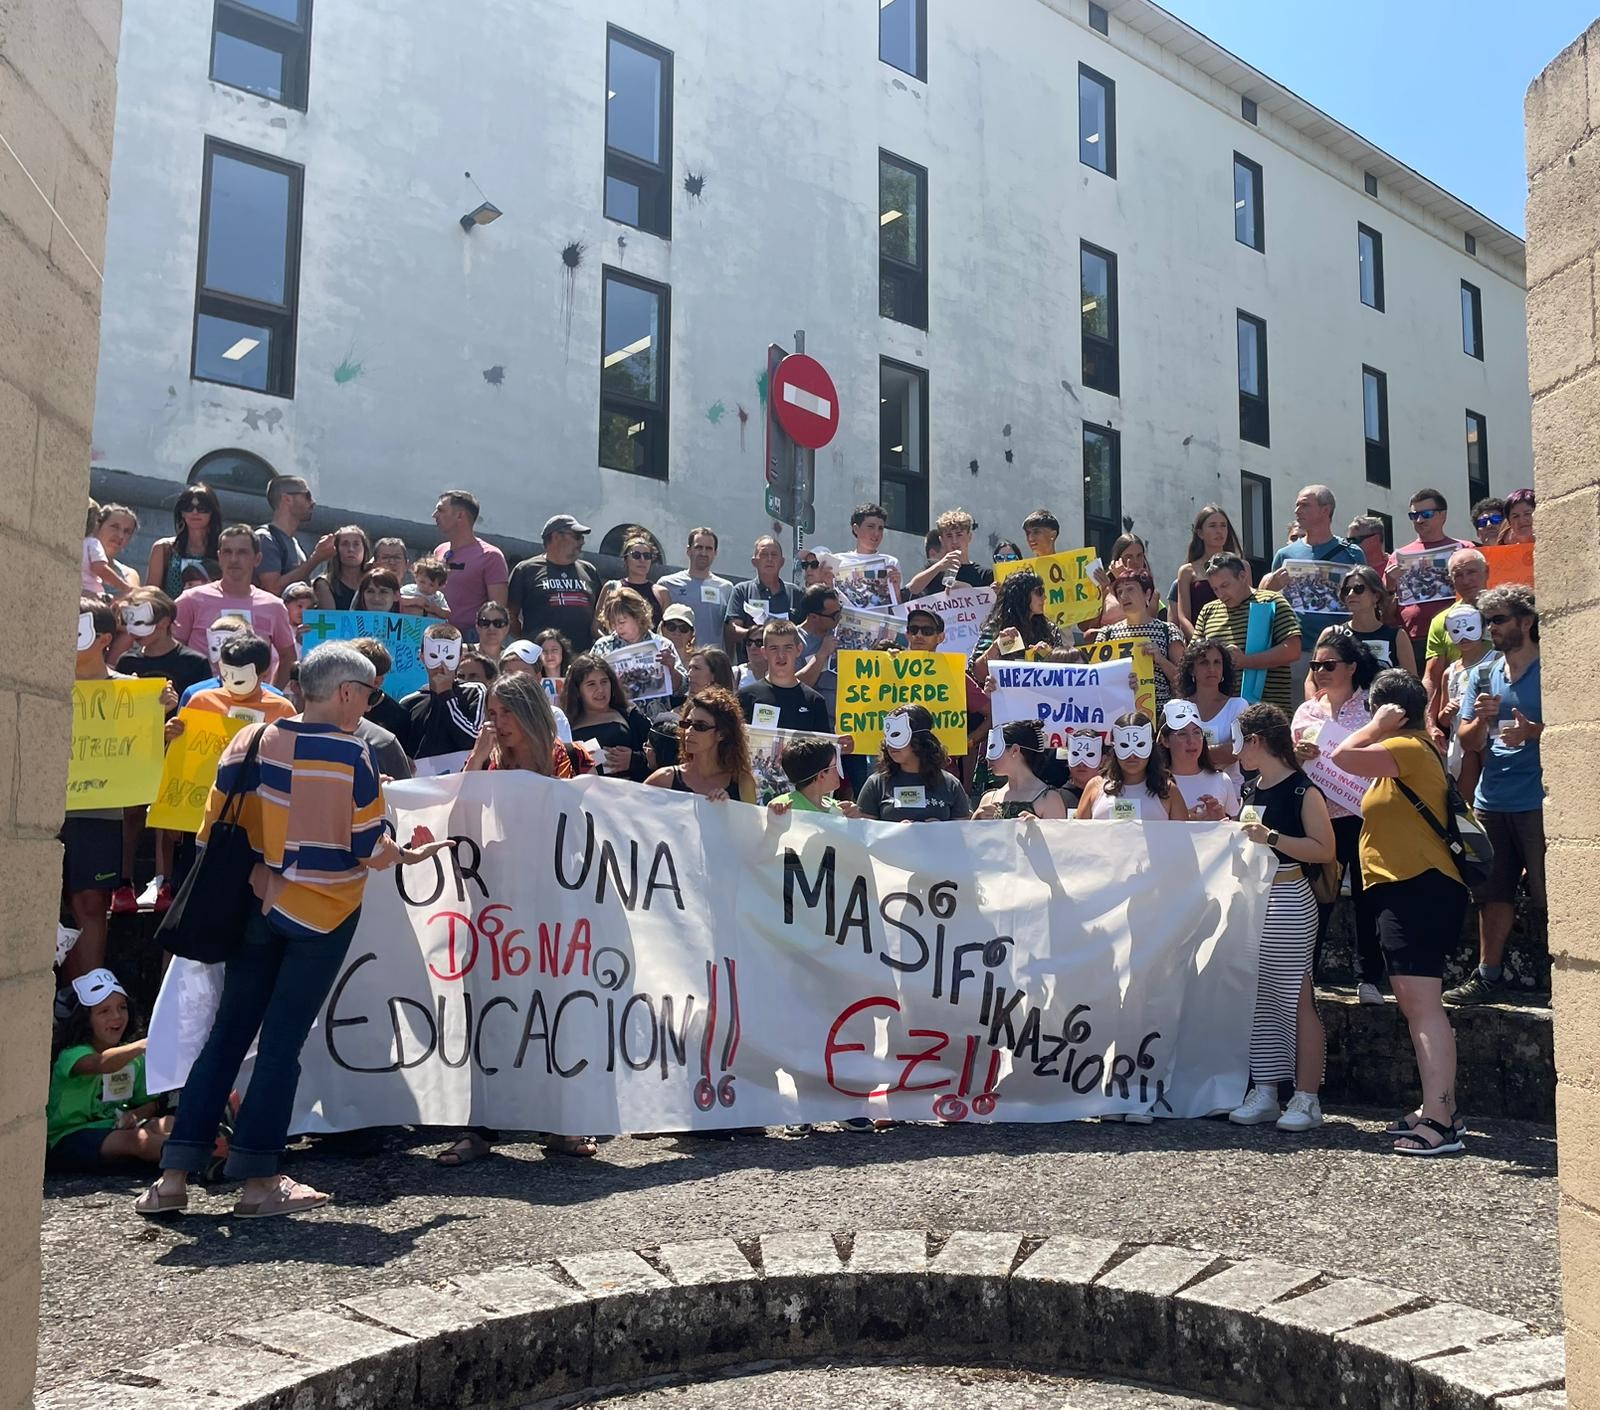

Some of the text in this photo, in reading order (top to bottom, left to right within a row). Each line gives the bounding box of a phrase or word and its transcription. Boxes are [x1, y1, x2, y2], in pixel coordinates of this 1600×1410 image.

[542, 579, 587, 590] NORWAY
[976, 593, 991, 605] EZ
[1456, 619, 1467, 628] 23
[436, 644, 449, 654] 14
[855, 656, 936, 679] MI VOZ
[845, 683, 949, 703] SE PIERDE
[1180, 705, 1193, 714] 25
[885, 722, 891, 732] 9
[1125, 732, 1139, 743] 15
[1077, 742, 1090, 752] 24
[1326, 767, 1337, 777] NO
[1310, 772, 1343, 795] NUESTRO
[554, 812, 686, 911] UNA
[60, 935, 75, 949] 20
[427, 904, 592, 981] DIGNA
[96, 973, 112, 983] 10
